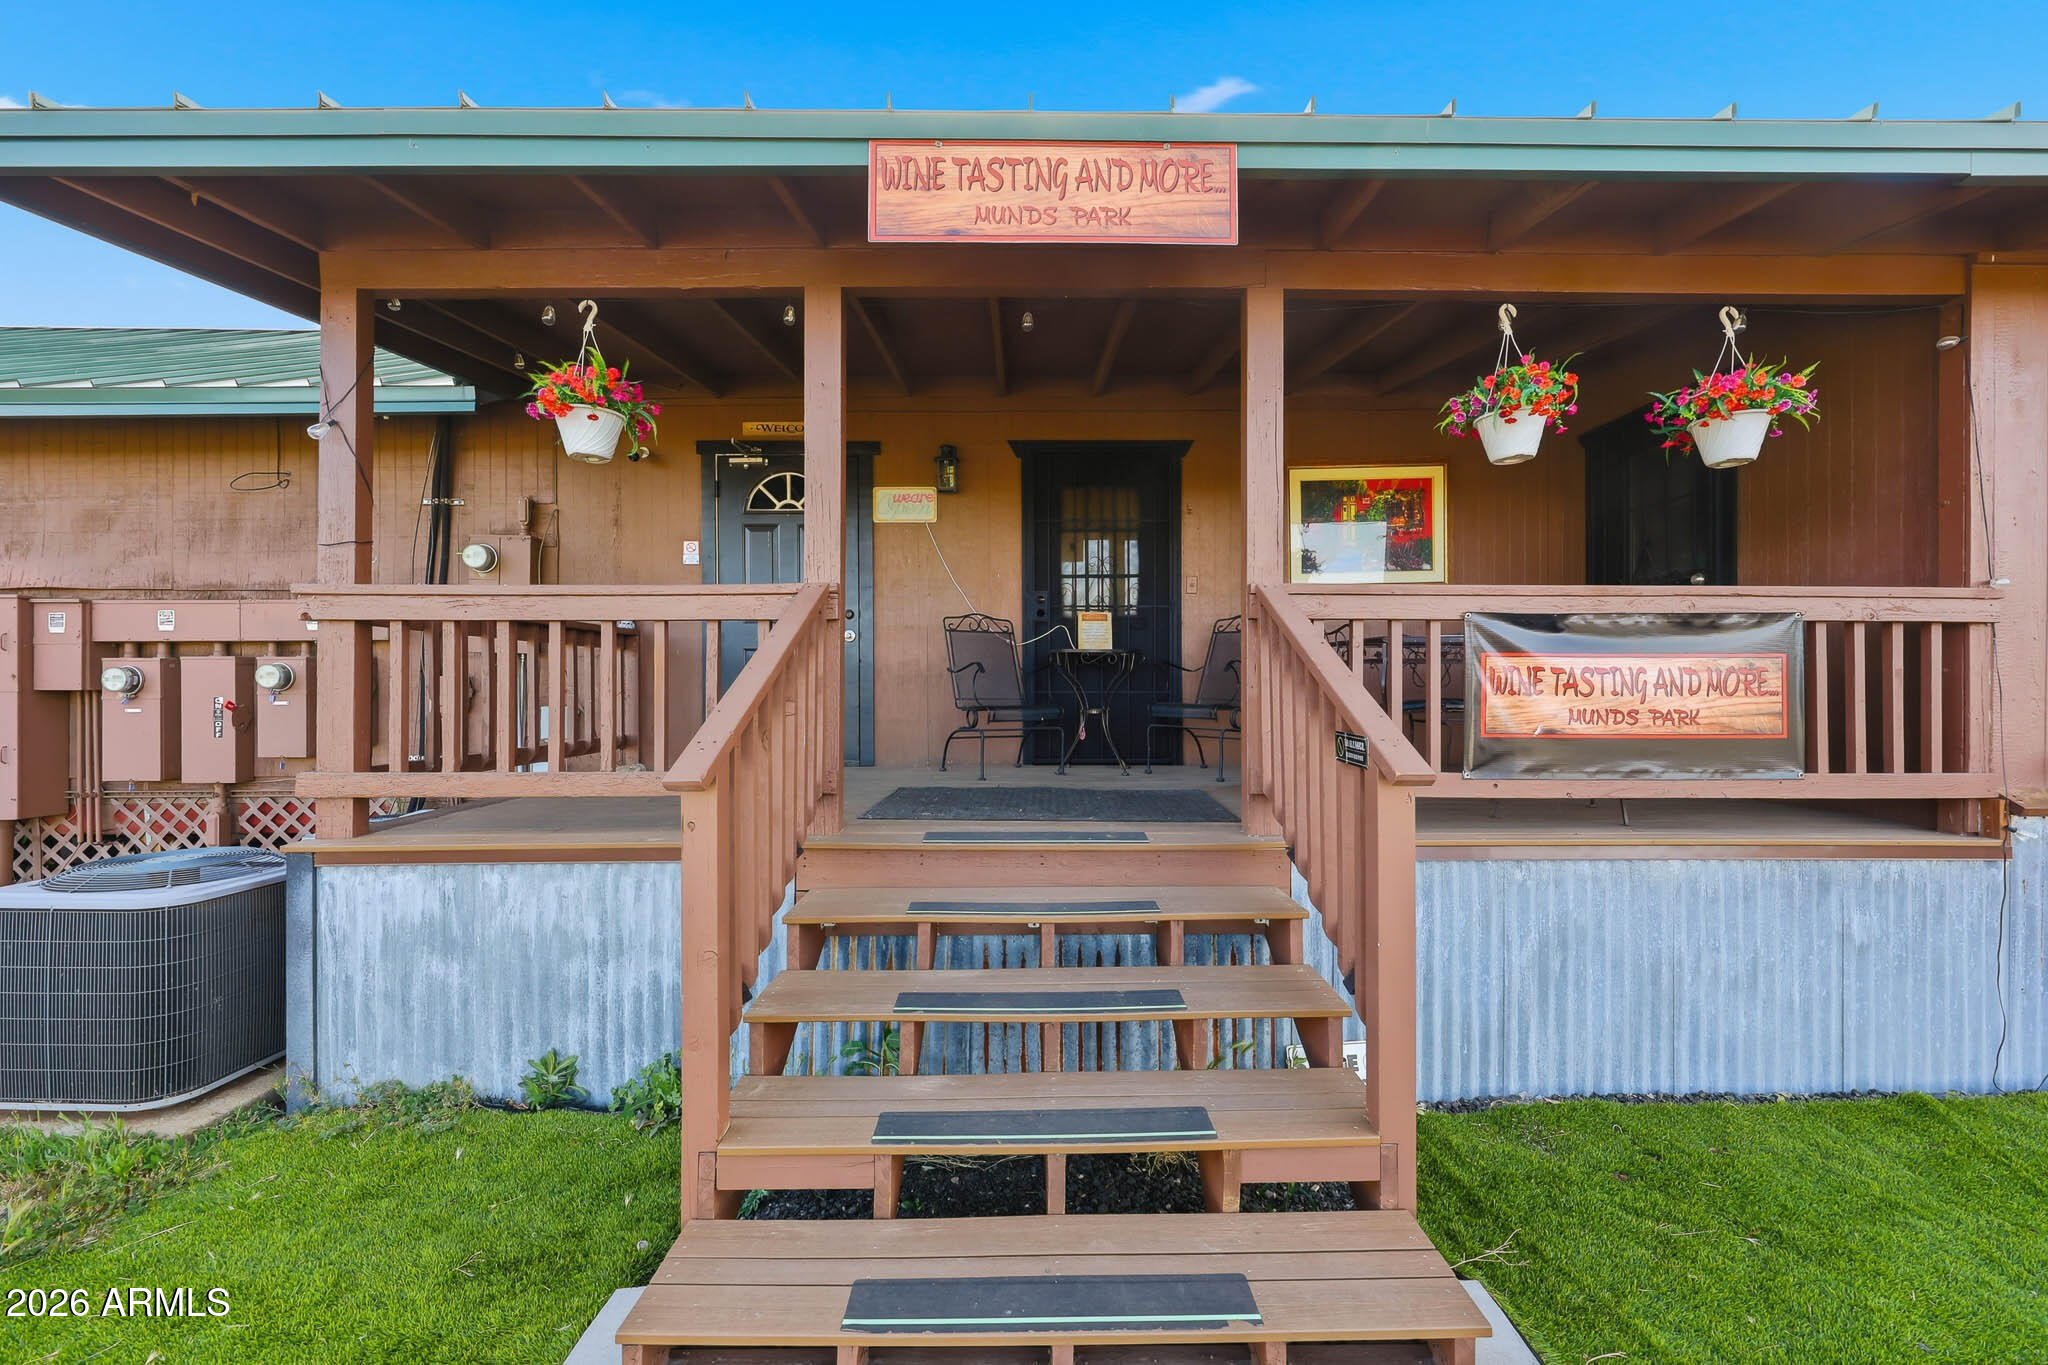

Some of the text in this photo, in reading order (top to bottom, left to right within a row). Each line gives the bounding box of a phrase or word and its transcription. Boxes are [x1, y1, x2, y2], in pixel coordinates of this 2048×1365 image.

[880, 155, 1226, 200] WINE TASTING AND MORE...
[974, 205, 1132, 226] MUNDS PARK
[756, 424, 805, 433] WELCO
[1489, 665, 1780, 704] WINE TASTING AND MORE...
[1568, 708, 1701, 727] MUNDS PARK
